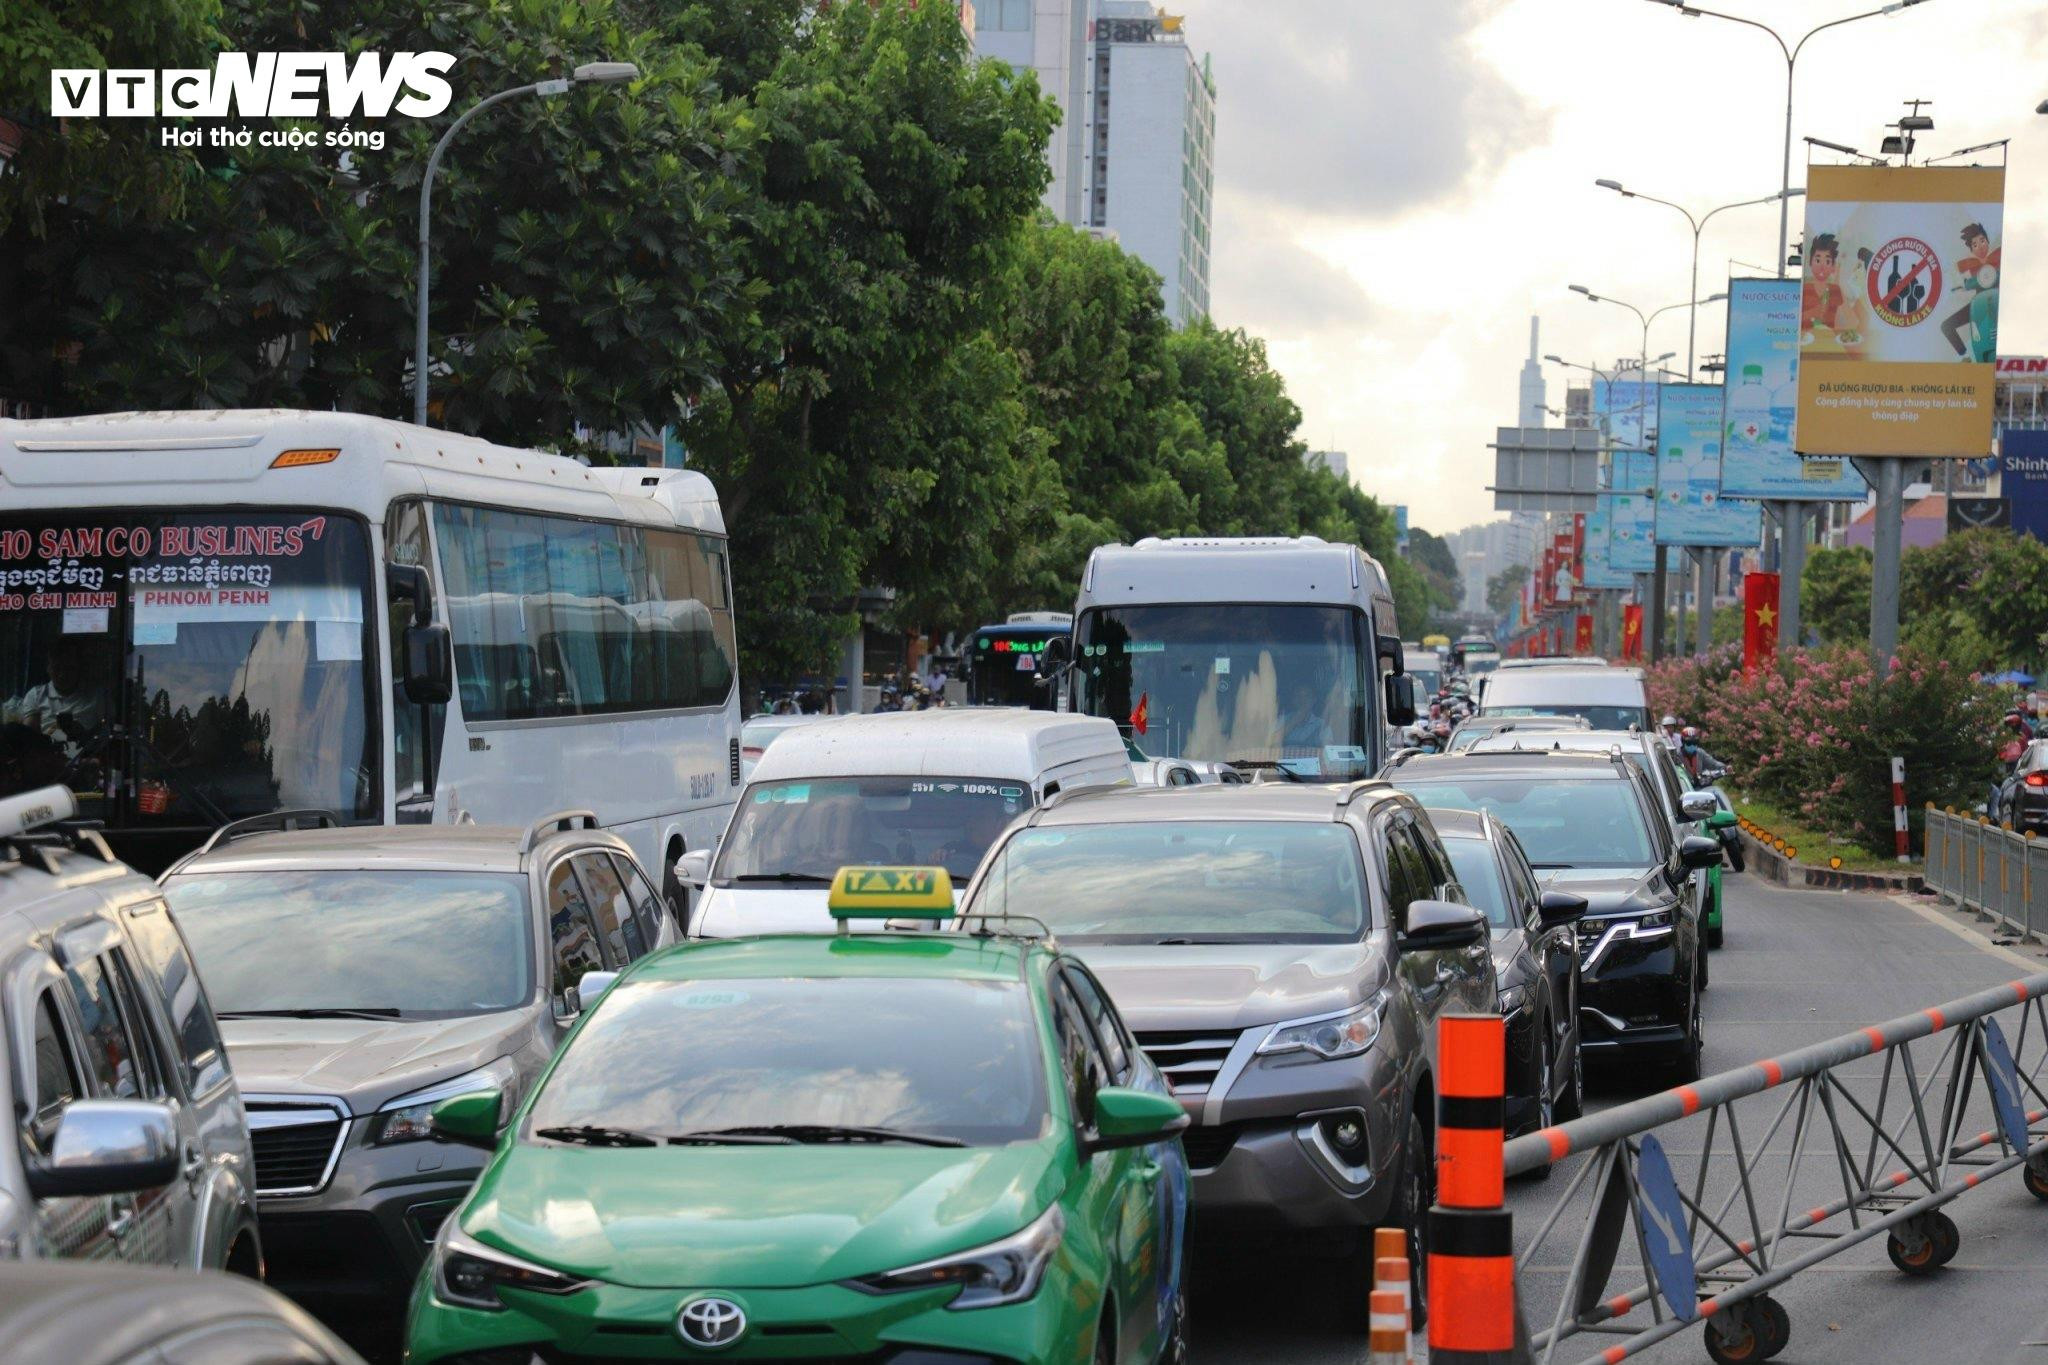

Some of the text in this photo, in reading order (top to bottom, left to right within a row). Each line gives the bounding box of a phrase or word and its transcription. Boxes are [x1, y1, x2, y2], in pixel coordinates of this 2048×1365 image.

[1889, 384, 1904, 393] BIA
[160, 526, 304, 557] BUSLINES
[28, 593, 62, 609] CHI
[66, 592, 117, 608] MINH
[144, 592, 212, 606] PHNOM
[218, 591, 270, 605] PENH
[963, 784, 998, 795] 100%
